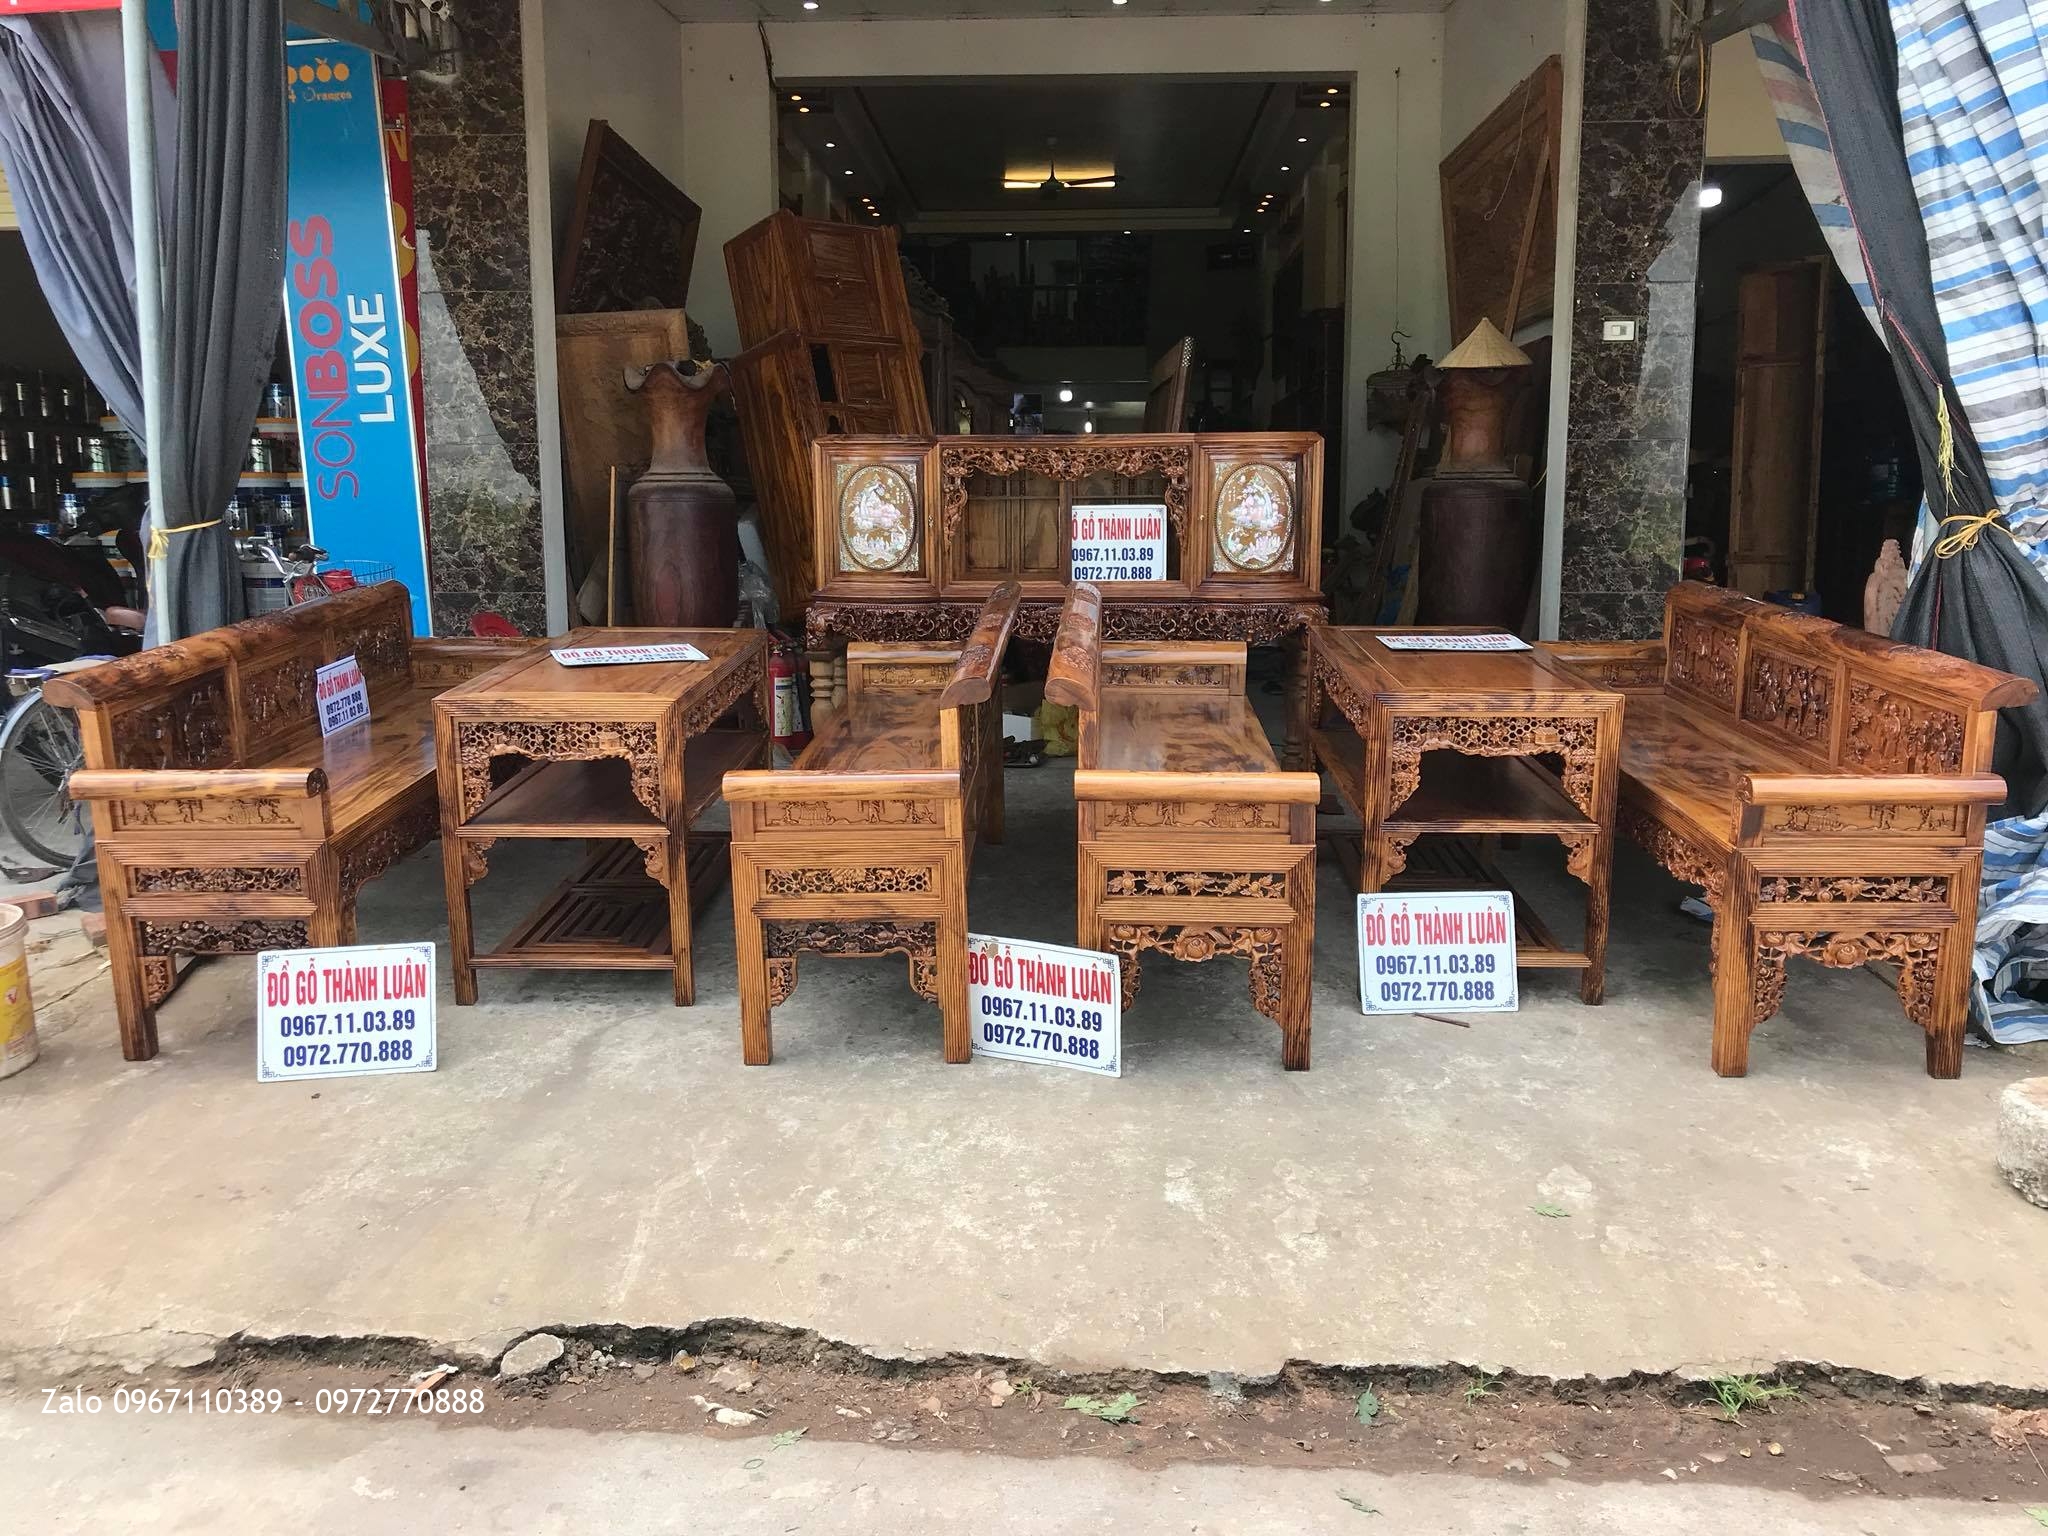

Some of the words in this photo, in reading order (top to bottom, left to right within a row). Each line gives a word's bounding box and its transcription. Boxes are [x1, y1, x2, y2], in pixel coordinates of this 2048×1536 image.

[347, 293, 395, 423] LUXE
[1098, 513, 1131, 540] THÀNH
[1134, 513, 1161, 540] LUÂN
[1072, 548, 1154, 561] 0967.11.03.89
[1074, 567, 1152, 580] 0972.770.888
[1366, 903, 1386, 946] ĐỒ
[1390, 902, 1411, 946] GỖ
[1414, 906, 1464, 945] THÀNH
[1468, 906, 1507, 945] LUÂN
[969, 943, 989, 987] ĐỒ
[993, 945, 1014, 990] GỖ
[1017, 954, 1067, 998] THÀNH
[1071, 962, 1112, 1005] LUÂN
[1376, 953, 1496, 976] 0967.11.03.89
[267, 959, 290, 1008] ĐỒ
[296, 957, 318, 1006] GỖ
[323, 960, 378, 1004] THÀNH
[383, 957, 427, 1000] LUÂN
[1381, 981, 1495, 1002] 0972.770.888
[280, 1009, 416, 1038] 0967.11.03.89
[981, 995, 1103, 1033] 0967.11.03.89
[283, 1039, 413, 1068] 0972.770.888
[983, 1022, 1100, 1060] 0972.770.888
